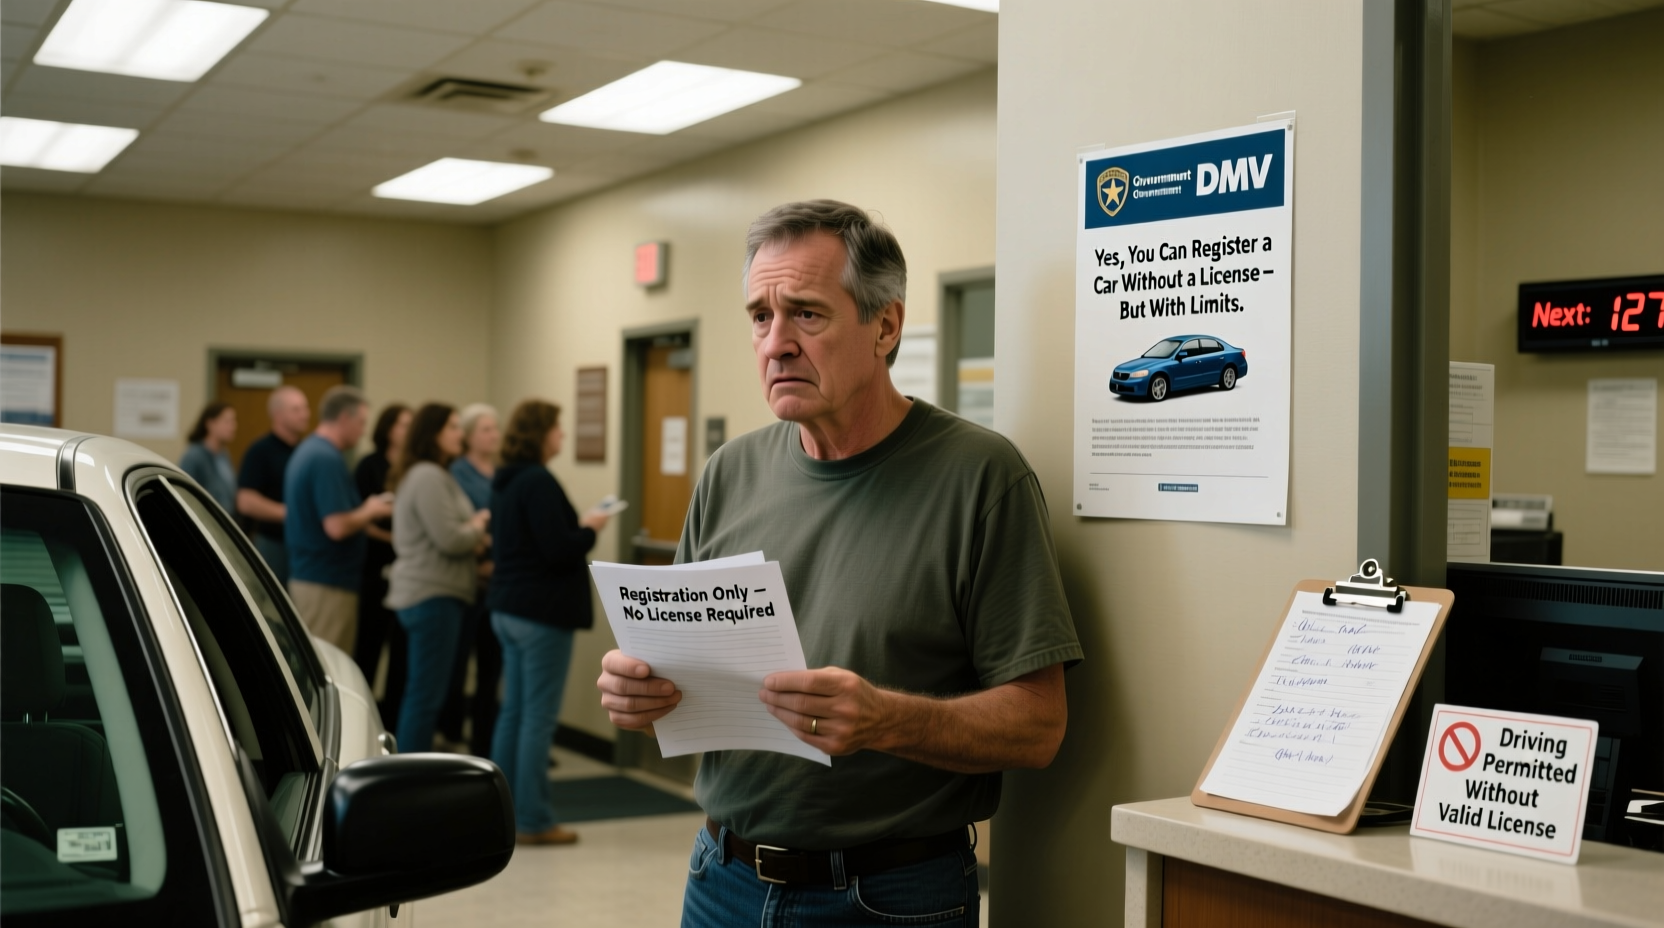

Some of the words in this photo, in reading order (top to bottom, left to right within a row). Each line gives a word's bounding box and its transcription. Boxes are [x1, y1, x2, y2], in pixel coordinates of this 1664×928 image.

[1196, 153, 1273, 196] DMV
[1095, 248, 1125, 270] Yes,
[1128, 244, 1155, 264] You
[1159, 242, 1187, 261] Can
[1192, 235, 1258, 262] Register
[1263, 236, 1272, 251] a
[1094, 276, 1119, 294] Car
[1122, 270, 1183, 291] Without
[1187, 272, 1196, 287] a
[1200, 266, 1260, 286] License
[1120, 300, 1146, 319] But
[1150, 296, 1186, 317] With
[1190, 292, 1244, 314] Limits.
[1532, 301, 1591, 328] Next:
[1611, 292, 1664, 331] 127
[619, 586, 708, 606] Registration
[713, 584, 748, 603] Only
[623, 606, 644, 621] No
[648, 607, 702, 622] License
[1499, 727, 1567, 760] Driving
[1483, 753, 1578, 785] Permitted
[1465, 779, 1539, 809] Without
[1439, 802, 1483, 828] Valid
[1487, 810, 1556, 840] License
